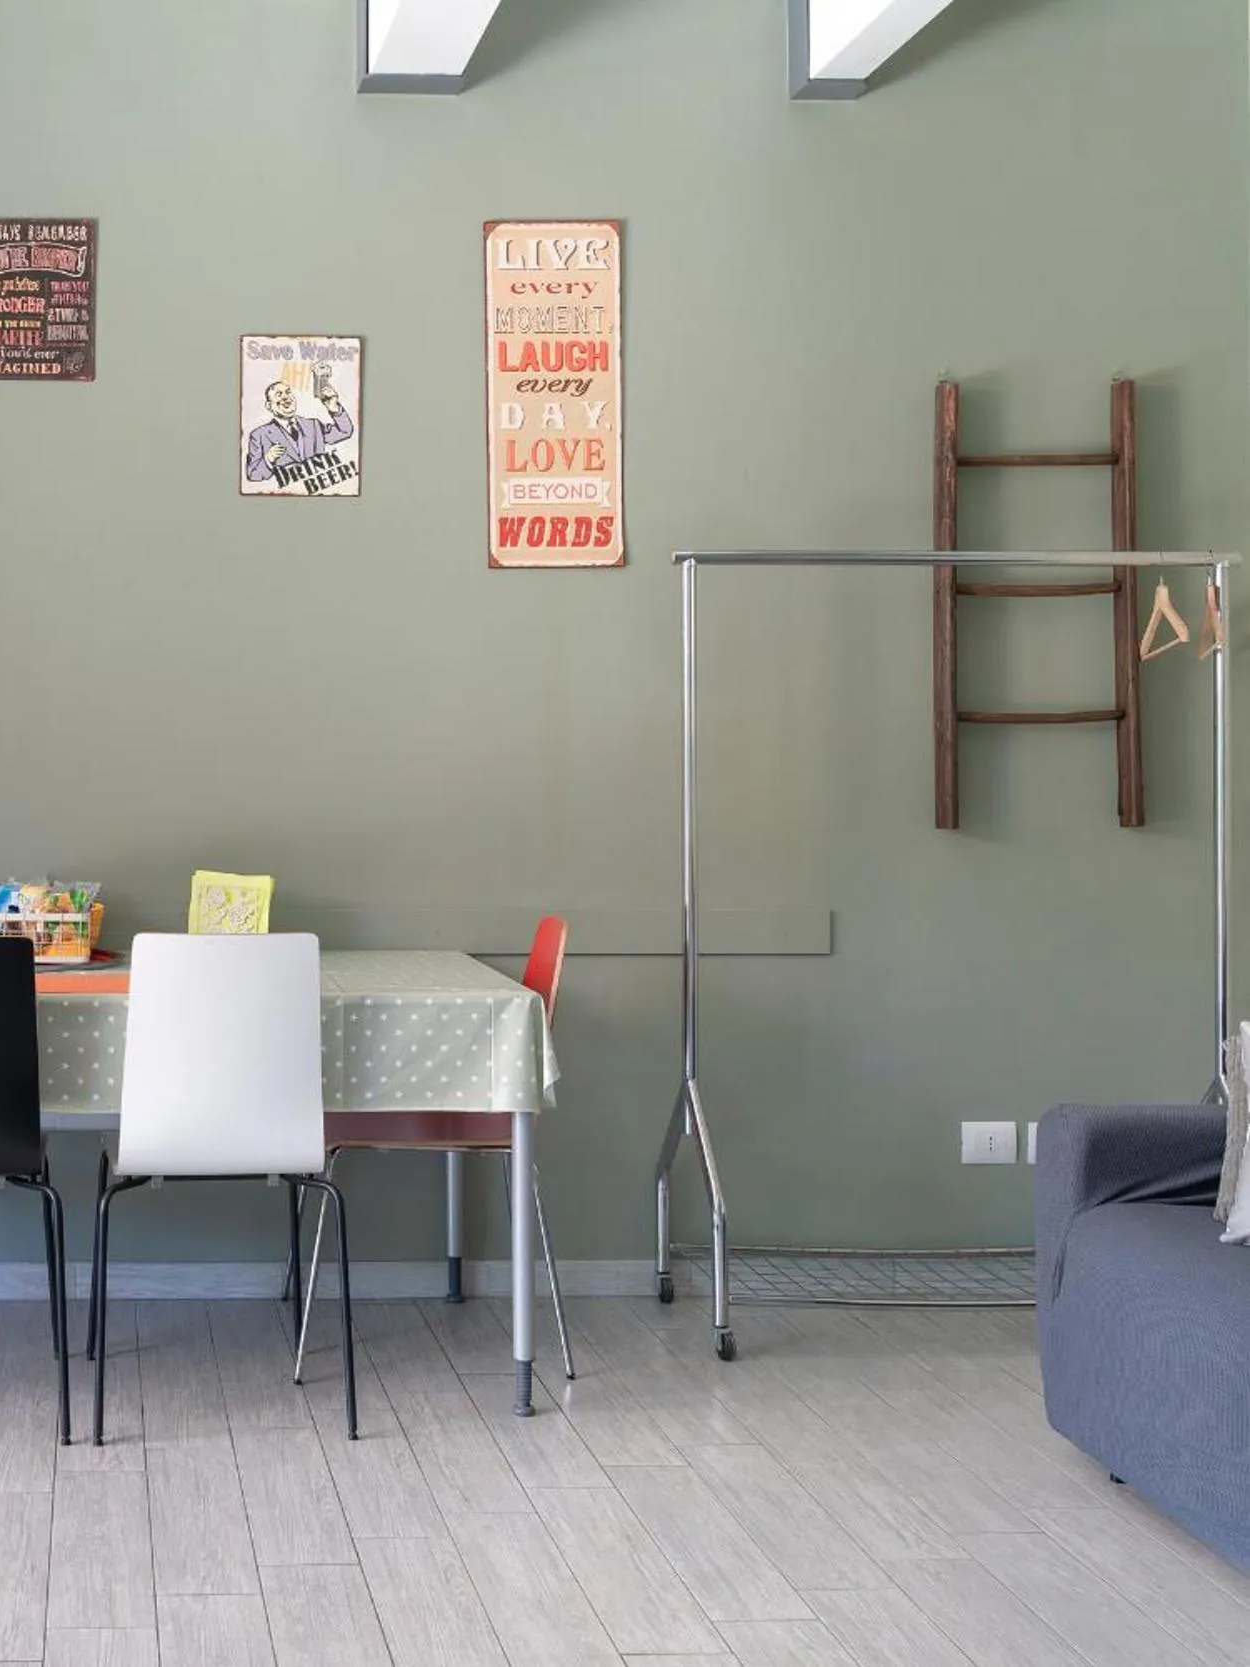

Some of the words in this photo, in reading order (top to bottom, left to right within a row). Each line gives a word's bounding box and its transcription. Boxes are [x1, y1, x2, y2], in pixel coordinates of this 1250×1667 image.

[495, 238, 612, 271] LIVE
[510, 280, 599, 299] every
[246, 340, 294, 361] Save
[298, 341, 358, 361] Water
[498, 340, 609, 372] LAUGH
[515, 376, 595, 397] every
[272, 449, 342, 488] DRINK
[505, 438, 607, 473] LOVE
[303, 460, 359, 495] BEER!
[512, 483, 599, 500] BEYOND
[498, 515, 615, 548] WORDS
